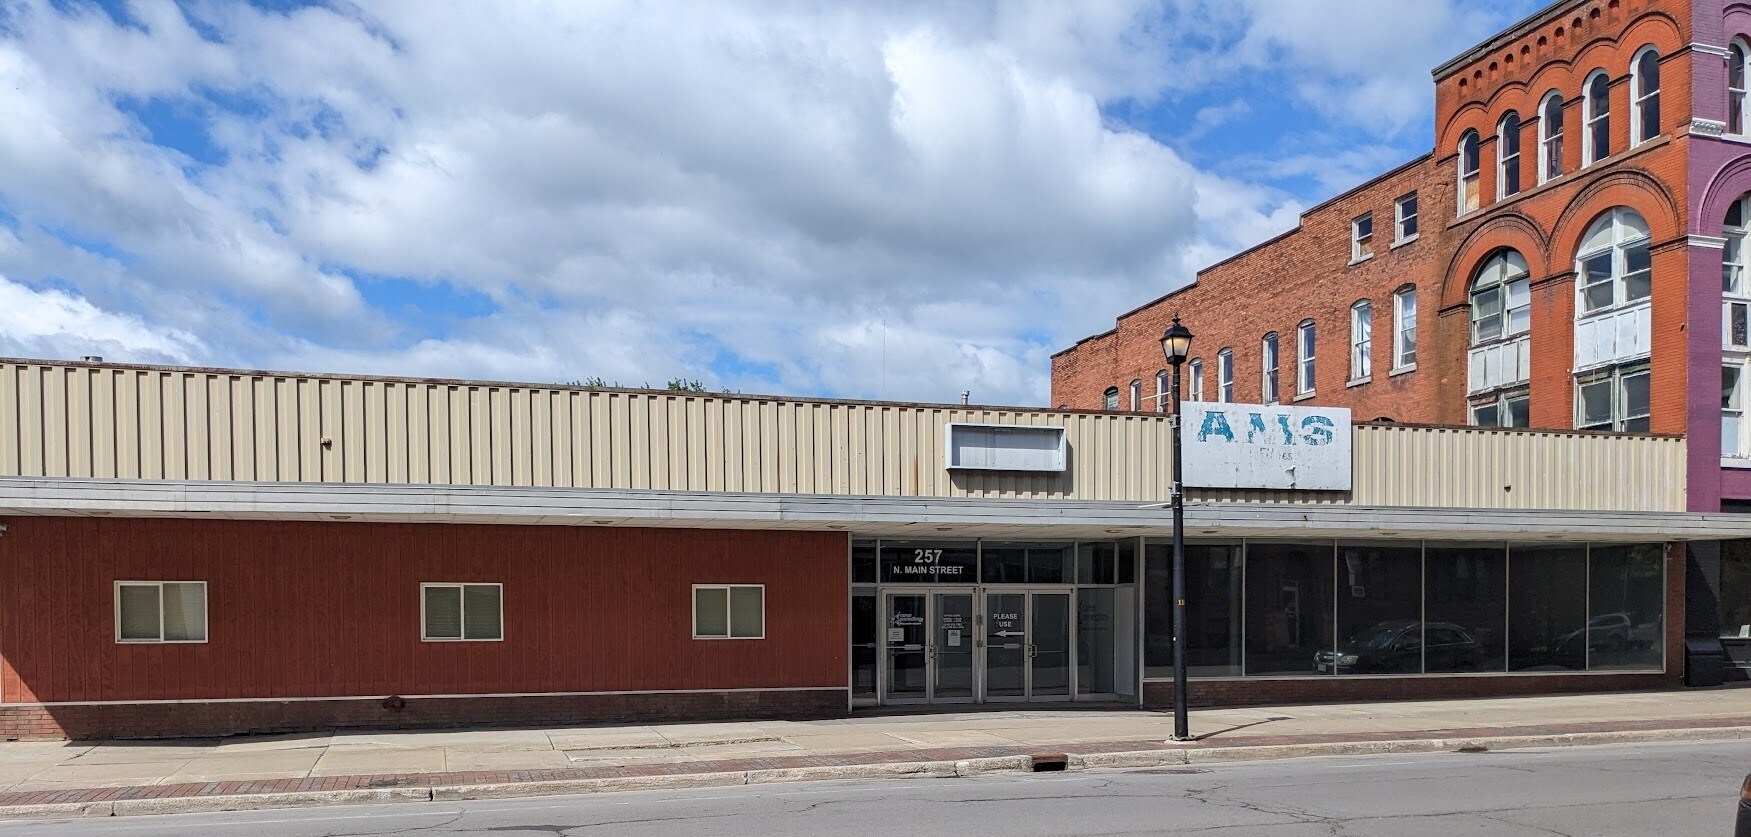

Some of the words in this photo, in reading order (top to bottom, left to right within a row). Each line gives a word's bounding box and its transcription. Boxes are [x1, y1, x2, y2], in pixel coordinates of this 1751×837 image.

[914, 549, 943, 564] 257
[893, 566, 903, 574] N.
[904, 566, 927, 575] MAIN
[929, 566, 964, 575] STREET
